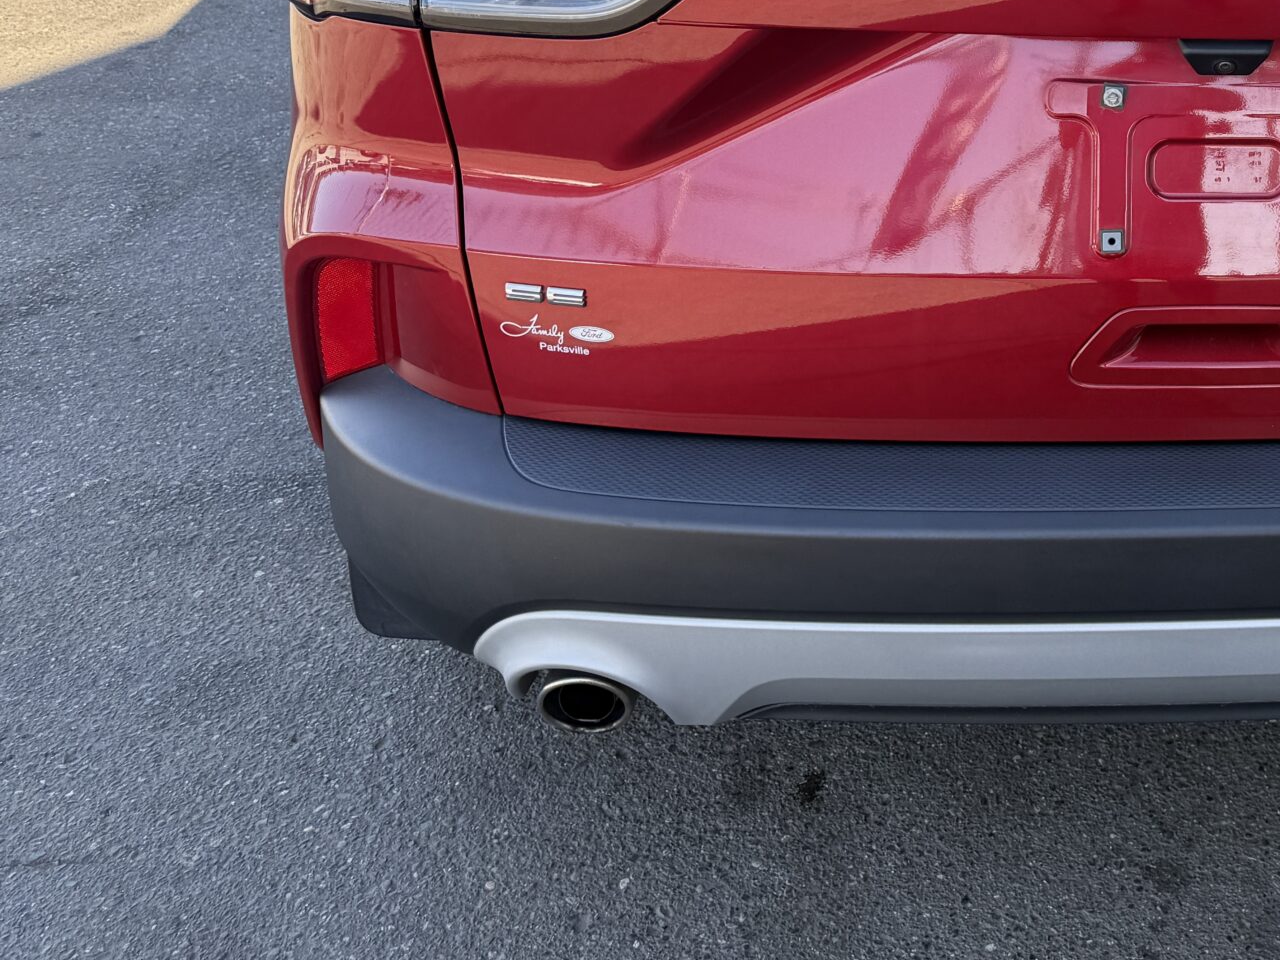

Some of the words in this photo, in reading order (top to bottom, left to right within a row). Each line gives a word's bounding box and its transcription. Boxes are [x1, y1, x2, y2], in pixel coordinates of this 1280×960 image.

[504, 281, 587, 308] SE
[499, 313, 565, 344] Family
[539, 341, 591, 356] Parksville
